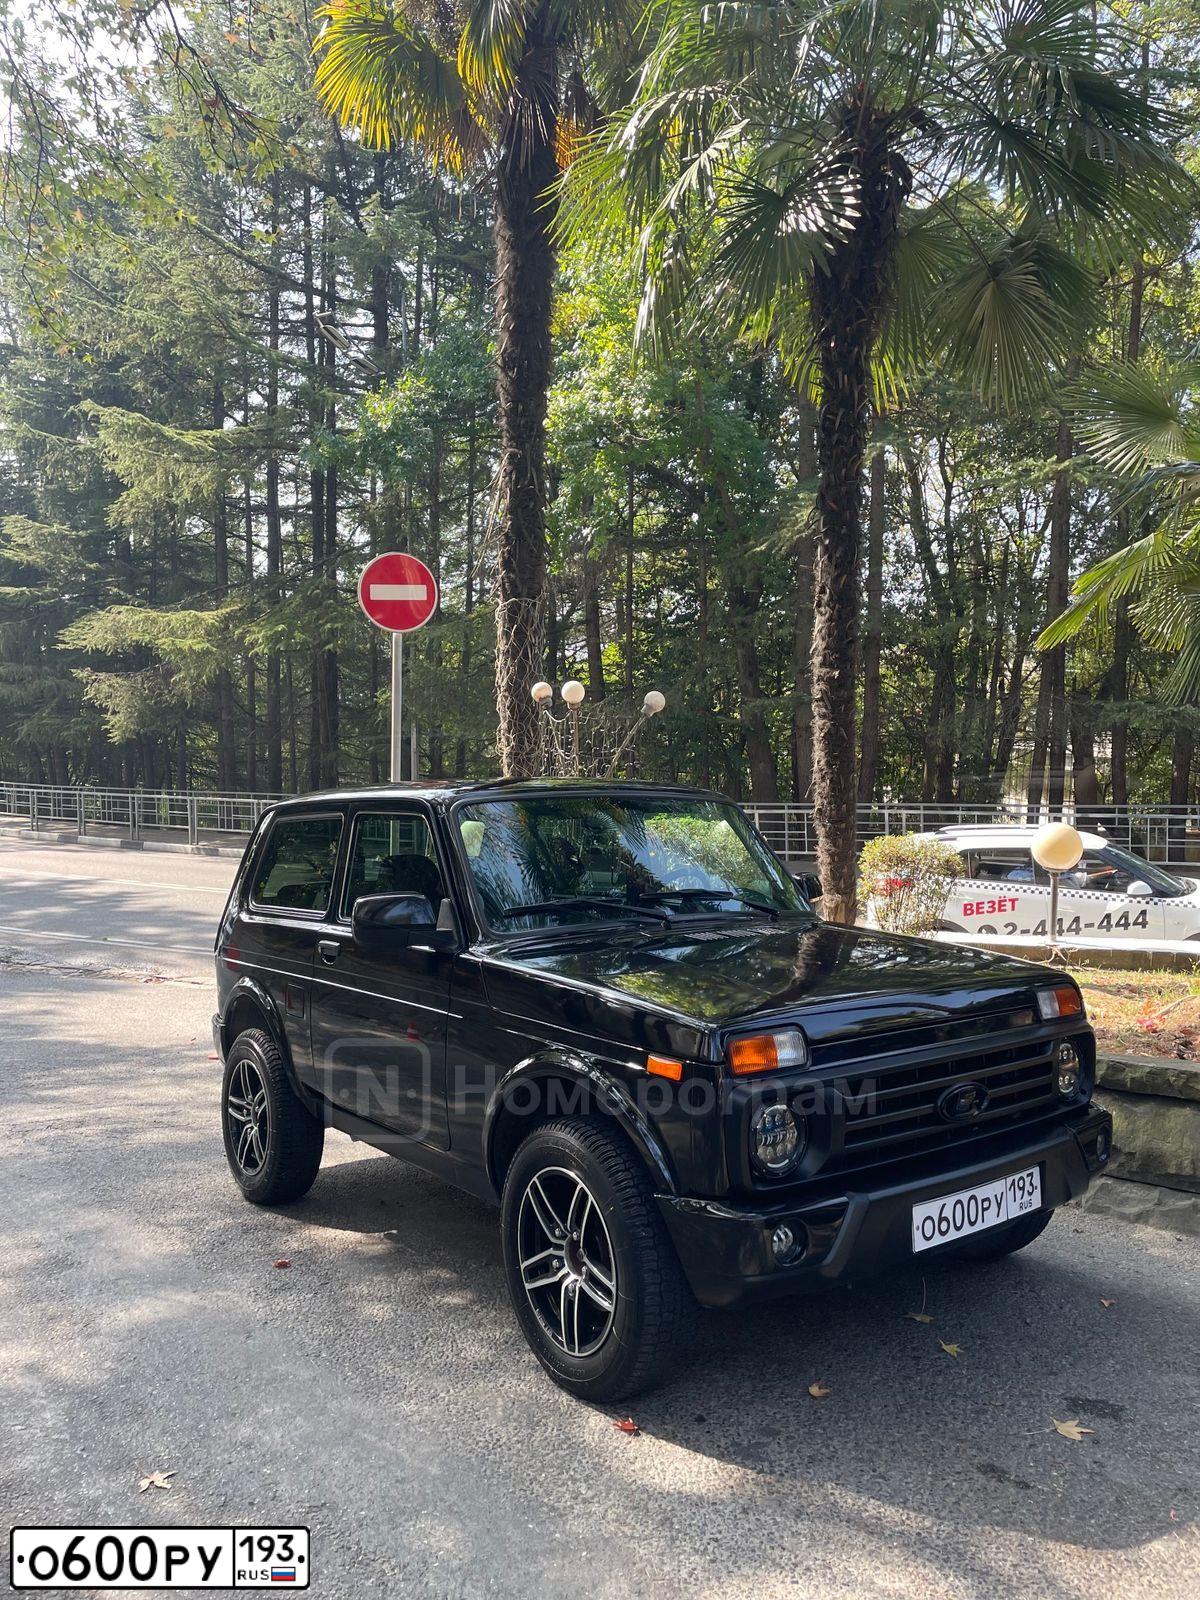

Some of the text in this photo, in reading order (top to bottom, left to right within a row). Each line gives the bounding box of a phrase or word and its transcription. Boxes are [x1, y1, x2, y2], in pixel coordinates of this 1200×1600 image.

[962, 896, 1019, 917] ВЕЗЁТ
[921, 1171, 1034, 1242] О600РУ 193
[1019, 1199, 1033, 1211] RUS
